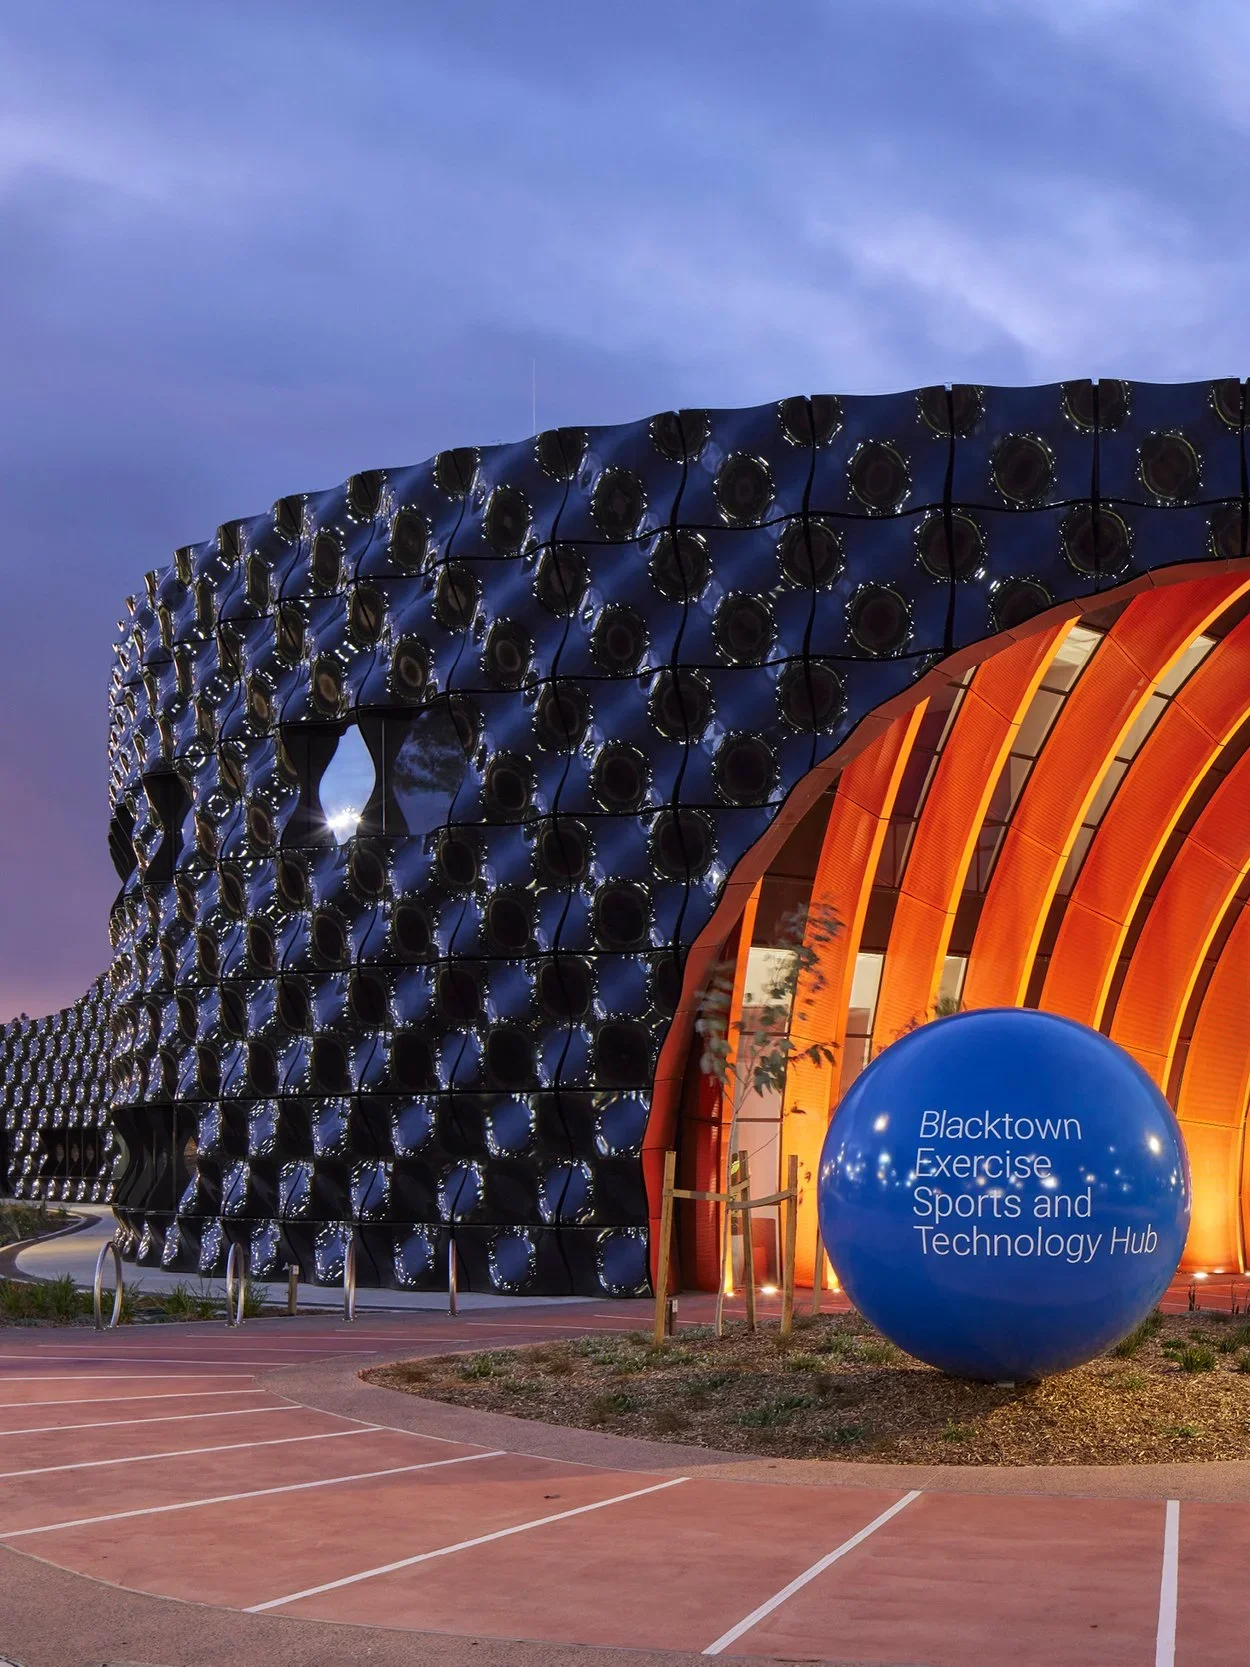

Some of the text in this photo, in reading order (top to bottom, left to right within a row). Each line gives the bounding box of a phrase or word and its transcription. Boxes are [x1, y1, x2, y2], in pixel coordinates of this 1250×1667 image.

[919, 1109, 1082, 1140] Blacktown
[915, 1147, 1052, 1179] Exercise
[913, 1186, 1091, 1224] Sports and
[913, 1224, 1158, 1264] Technology Hub
